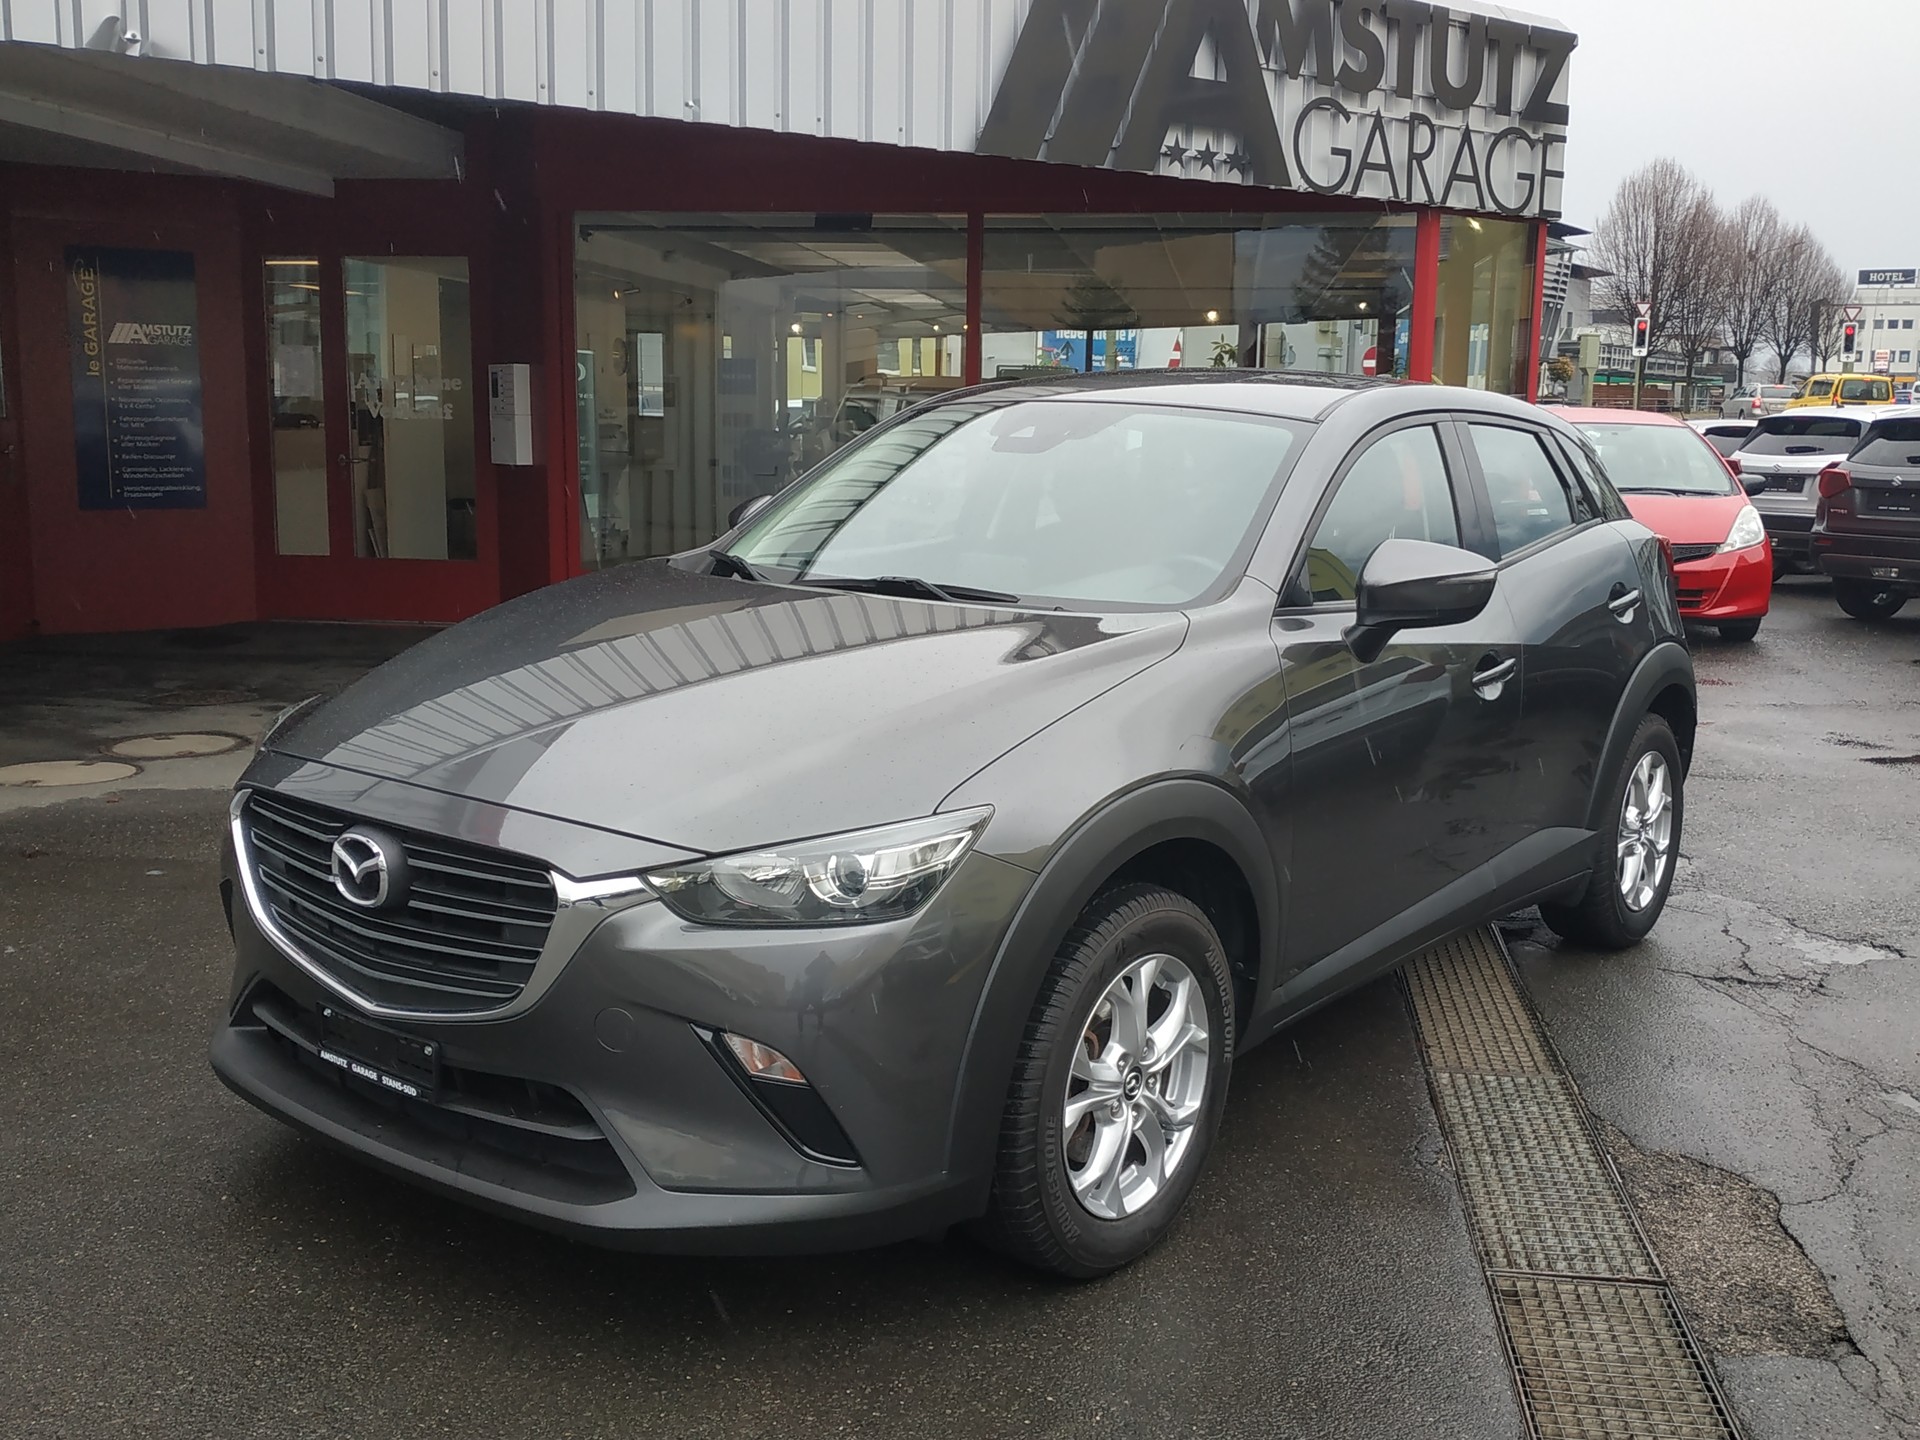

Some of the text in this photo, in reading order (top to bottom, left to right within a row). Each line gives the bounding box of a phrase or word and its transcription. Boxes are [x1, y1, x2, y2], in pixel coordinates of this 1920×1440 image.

[976, 0, 1577, 187] AMSTUTZ
[1293, 97, 1567, 218] GARAGE
[1869, 272, 1905, 282] HOTEL
[79, 266, 101, 376] le GARAGE
[147, 335, 192, 346] GARAGE
[320, 1050, 349, 1069] AMSTUTZ
[351, 1063, 379, 1082] GARAGE
